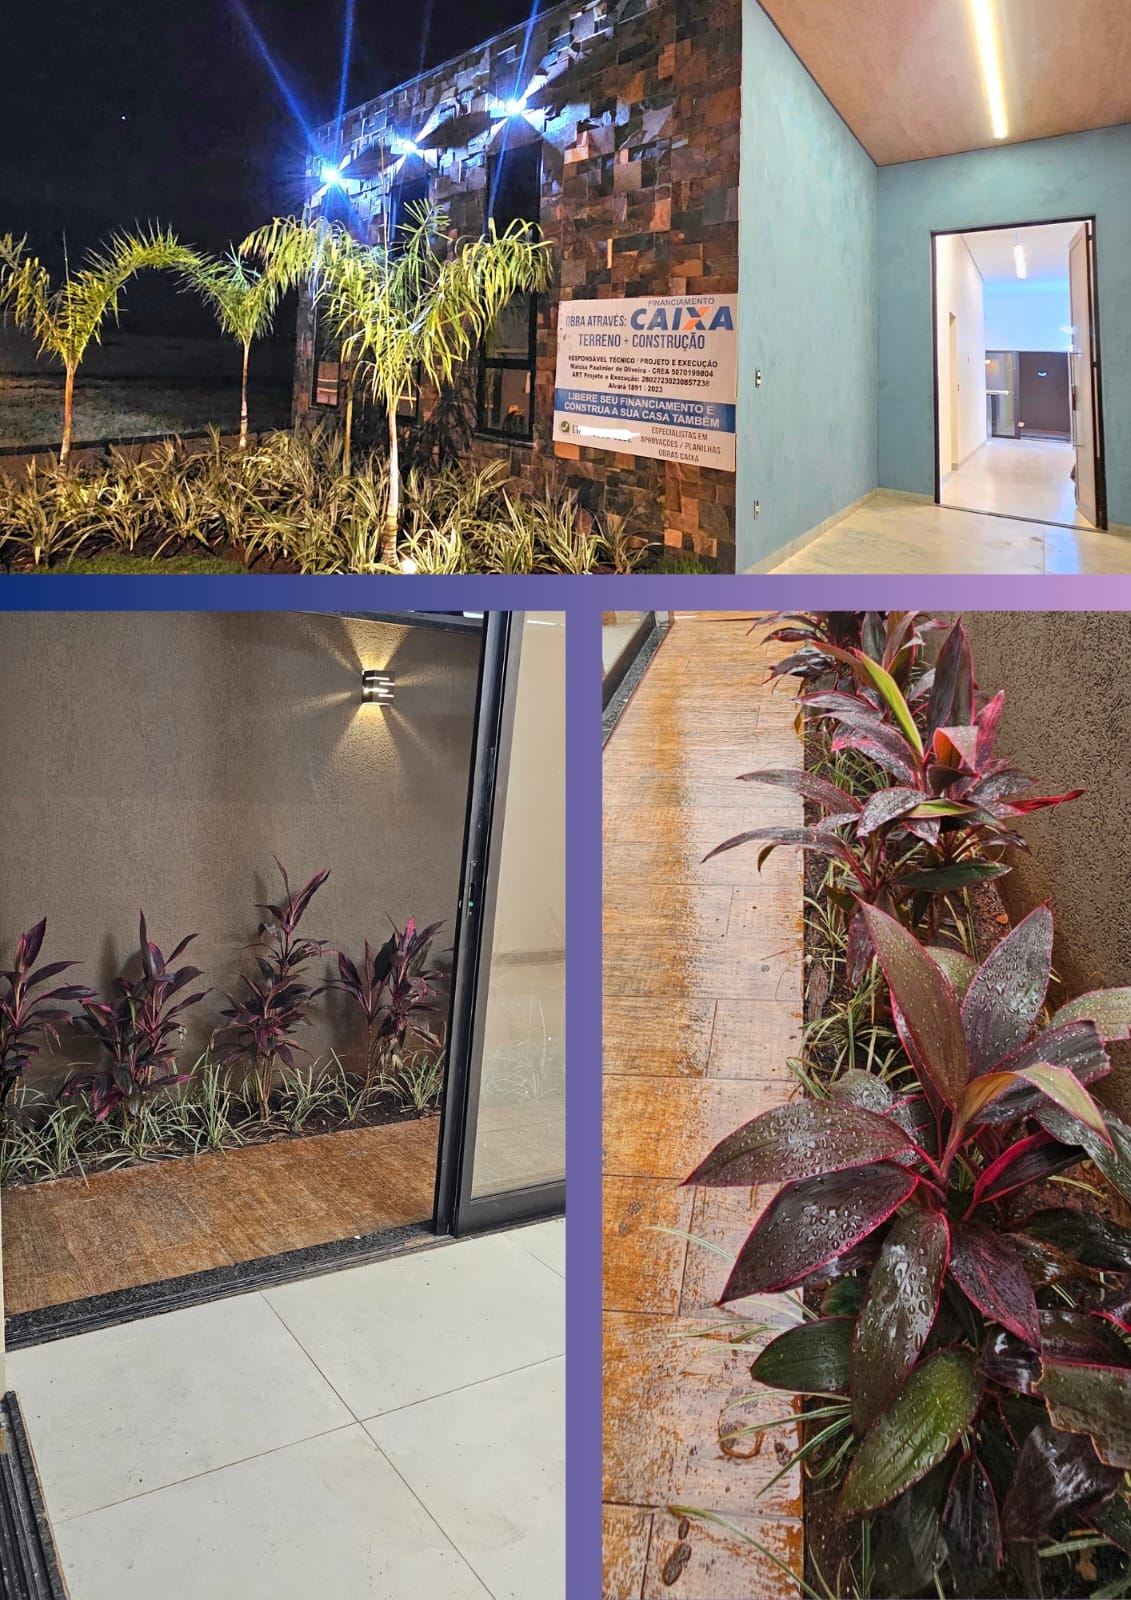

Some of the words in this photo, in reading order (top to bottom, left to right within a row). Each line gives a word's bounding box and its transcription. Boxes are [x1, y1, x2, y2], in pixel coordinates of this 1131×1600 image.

[648, 297, 715, 306] FINANCIAMENTO
[566, 315, 585, 327] OBRA
[587, 312, 627, 327] ATRAVÉS:
[630, 306, 734, 331] CAIXA
[579, 333, 621, 347] TERRENO
[632, 332, 705, 351] CONSTRUÇÃO
[568, 355, 607, 363] RESPONSÁVEL
[609, 356, 635, 364] TÉCNICO
[640, 358, 670, 366] PROJETO
[677, 359, 718, 369] EXECUÇÃO
[584, 372, 603, 381] Projeto
[623, 366, 647, 374] Oliveira
[652, 367, 670, 375] CREA
[628, 383, 642, 391] 1891
[647, 385, 663, 393] 2023
[568, 392, 598, 402] LIBERE
[600, 395, 618, 405] SEU
[620, 397, 704, 414] FINANCIAMENTO
[706, 405, 715, 415] E
[564, 401, 611, 415] CONSTRUA
[611, 407, 618, 416] A
[620, 408, 640, 419] SUA
[641, 410, 670, 422] CASA
[672, 413, 720, 428] TAMBÉM
[651, 426, 697, 440] ESPECIALISTAS
[698, 432, 708, 441] EM
[658, 448, 679, 459] OBRAS
[680, 453, 700, 462] CAIXA
[685, 442, 721, 455] PLANILHAS
